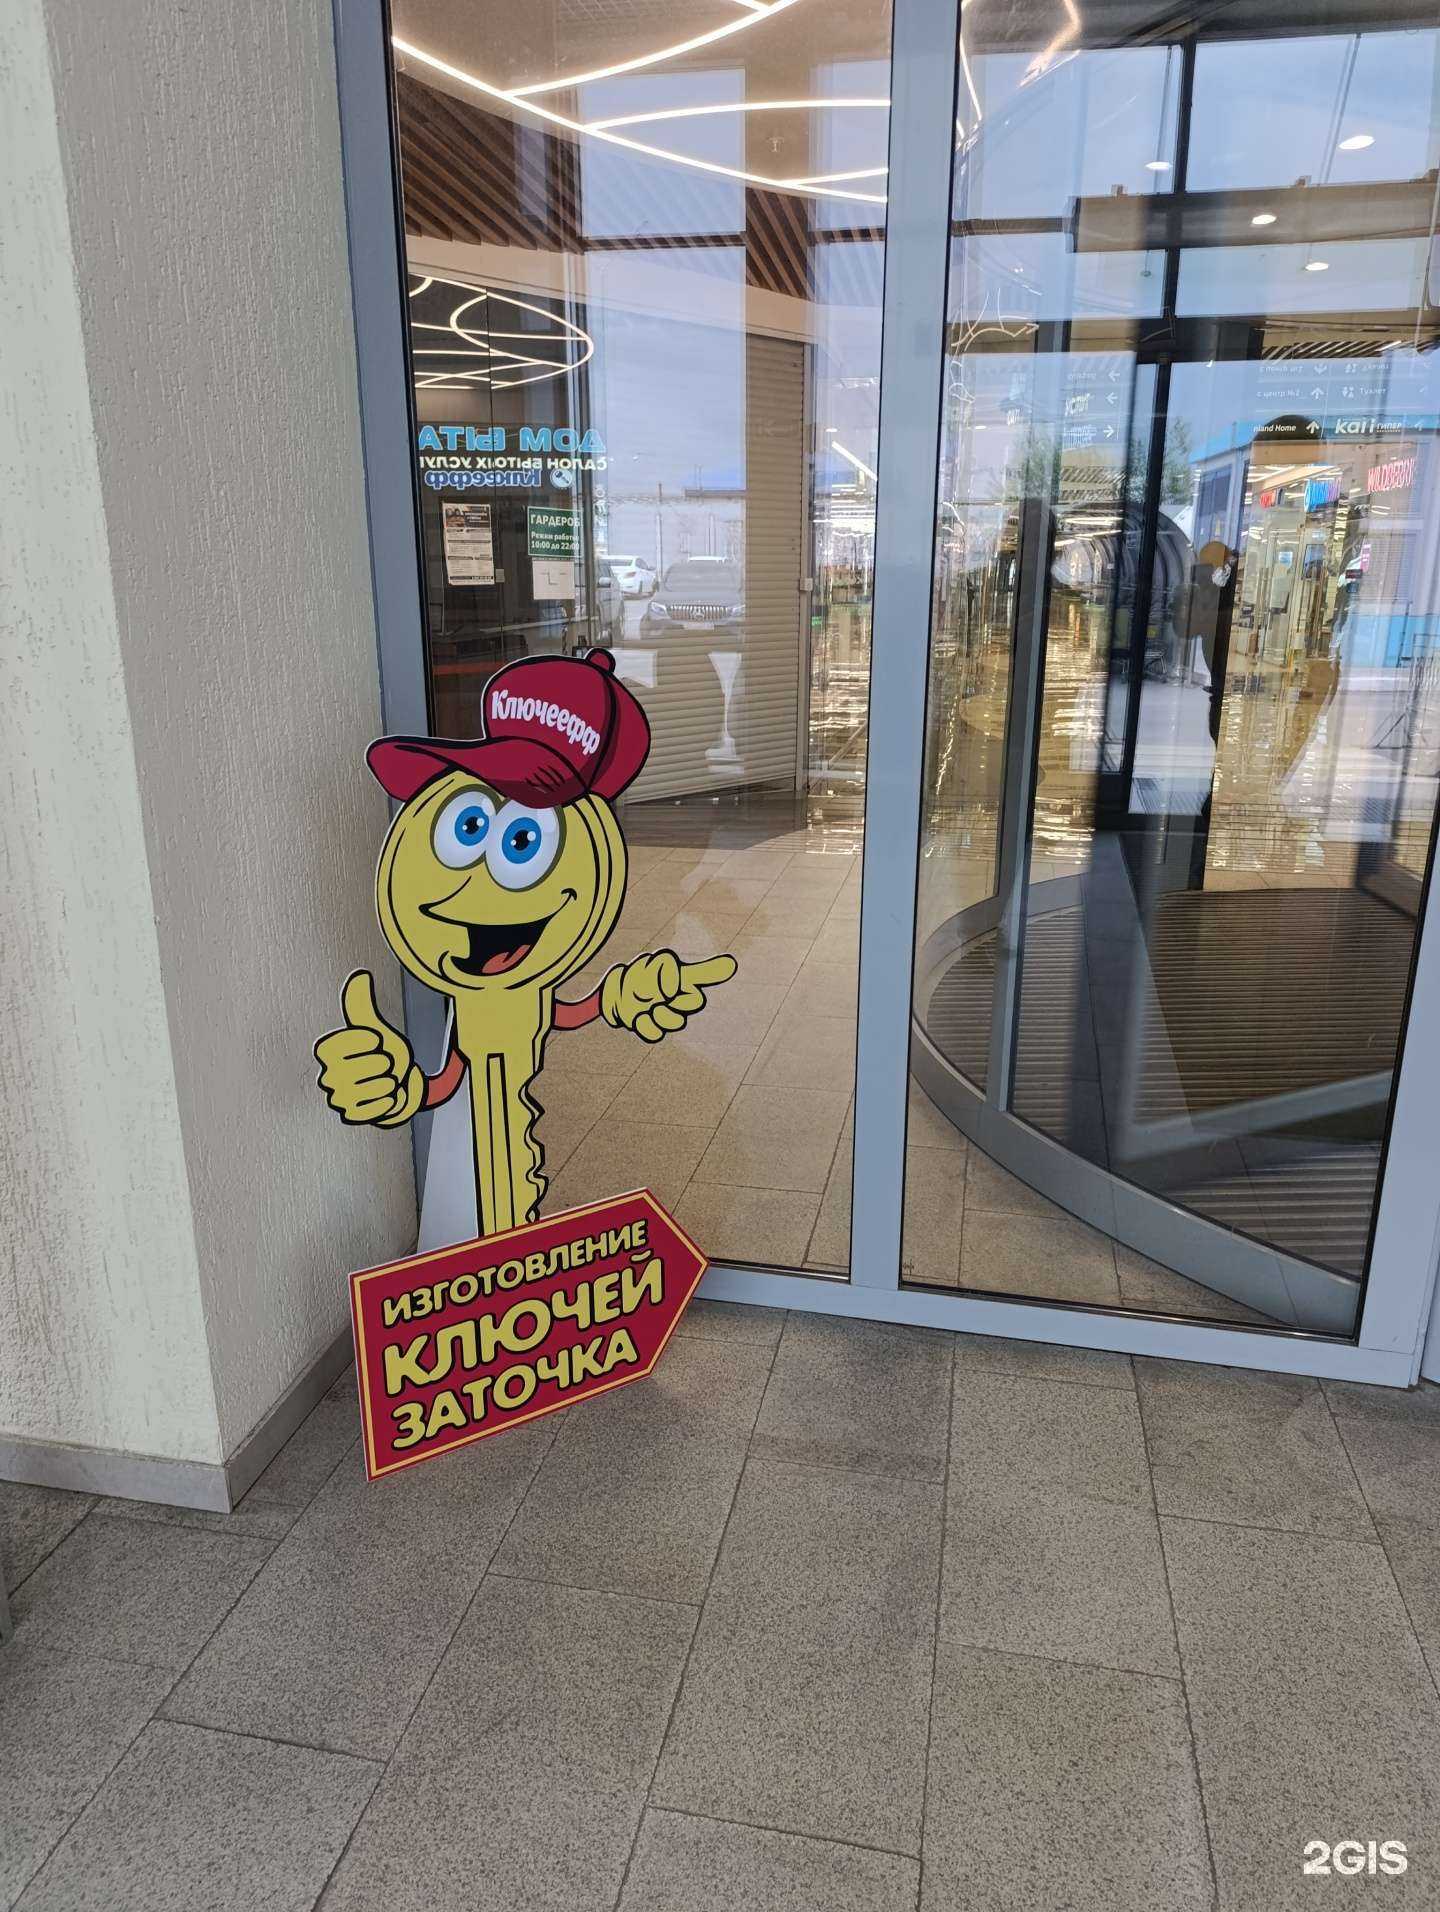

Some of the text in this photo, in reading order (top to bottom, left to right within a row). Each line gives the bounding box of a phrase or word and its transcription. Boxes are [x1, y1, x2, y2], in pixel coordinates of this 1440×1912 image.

[1275, 424, 1297, 432] Home
[530, 513, 581, 527] ГАРДЕРОБ
[531, 531, 553, 541] Режим
[531, 540, 580, 551] 10:00 до 22:00
[491, 689, 601, 756] Ключеефф
[382, 1219, 647, 1327] ИЗГОТОВЛЕНИЕ
[383, 1249, 663, 1395] КЛЮЧЕЙ
[391, 1328, 638, 1449] ЗАТОЧКА
